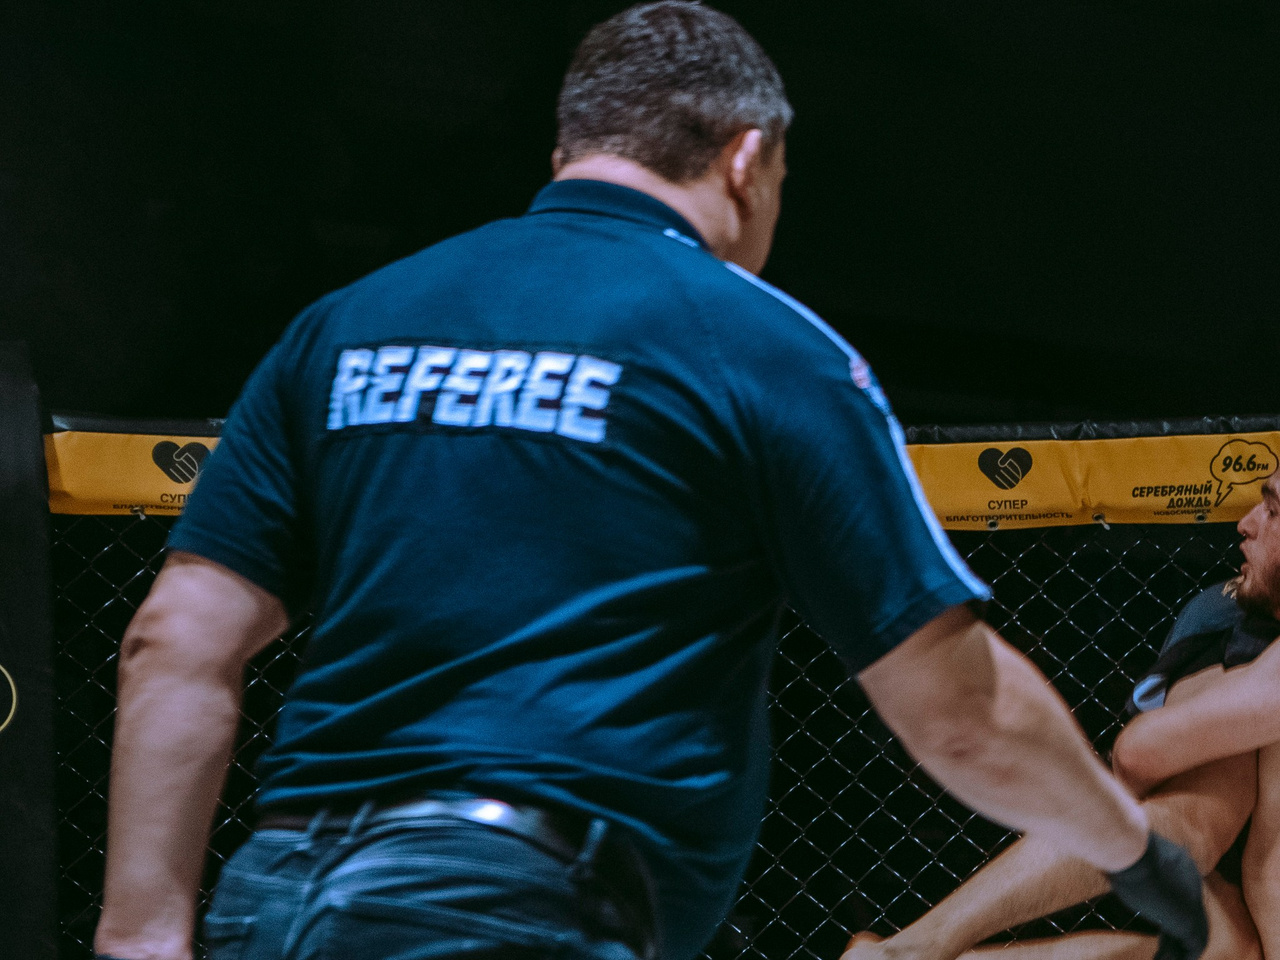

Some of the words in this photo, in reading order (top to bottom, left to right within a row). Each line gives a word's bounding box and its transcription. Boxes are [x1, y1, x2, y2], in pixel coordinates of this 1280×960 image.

[327, 346, 623, 443] REFEREE
[1132, 480, 1213, 498] СЕРЕБРЯНЫЙ
[160, 493, 186, 503] СУП
[1166, 496, 1211, 509] ДОЖДЬ
[987, 499, 1028, 510] СУПЕР
[945, 511, 1073, 523] БЛАГОТВОРИТЕЛЬНОСТЬ
